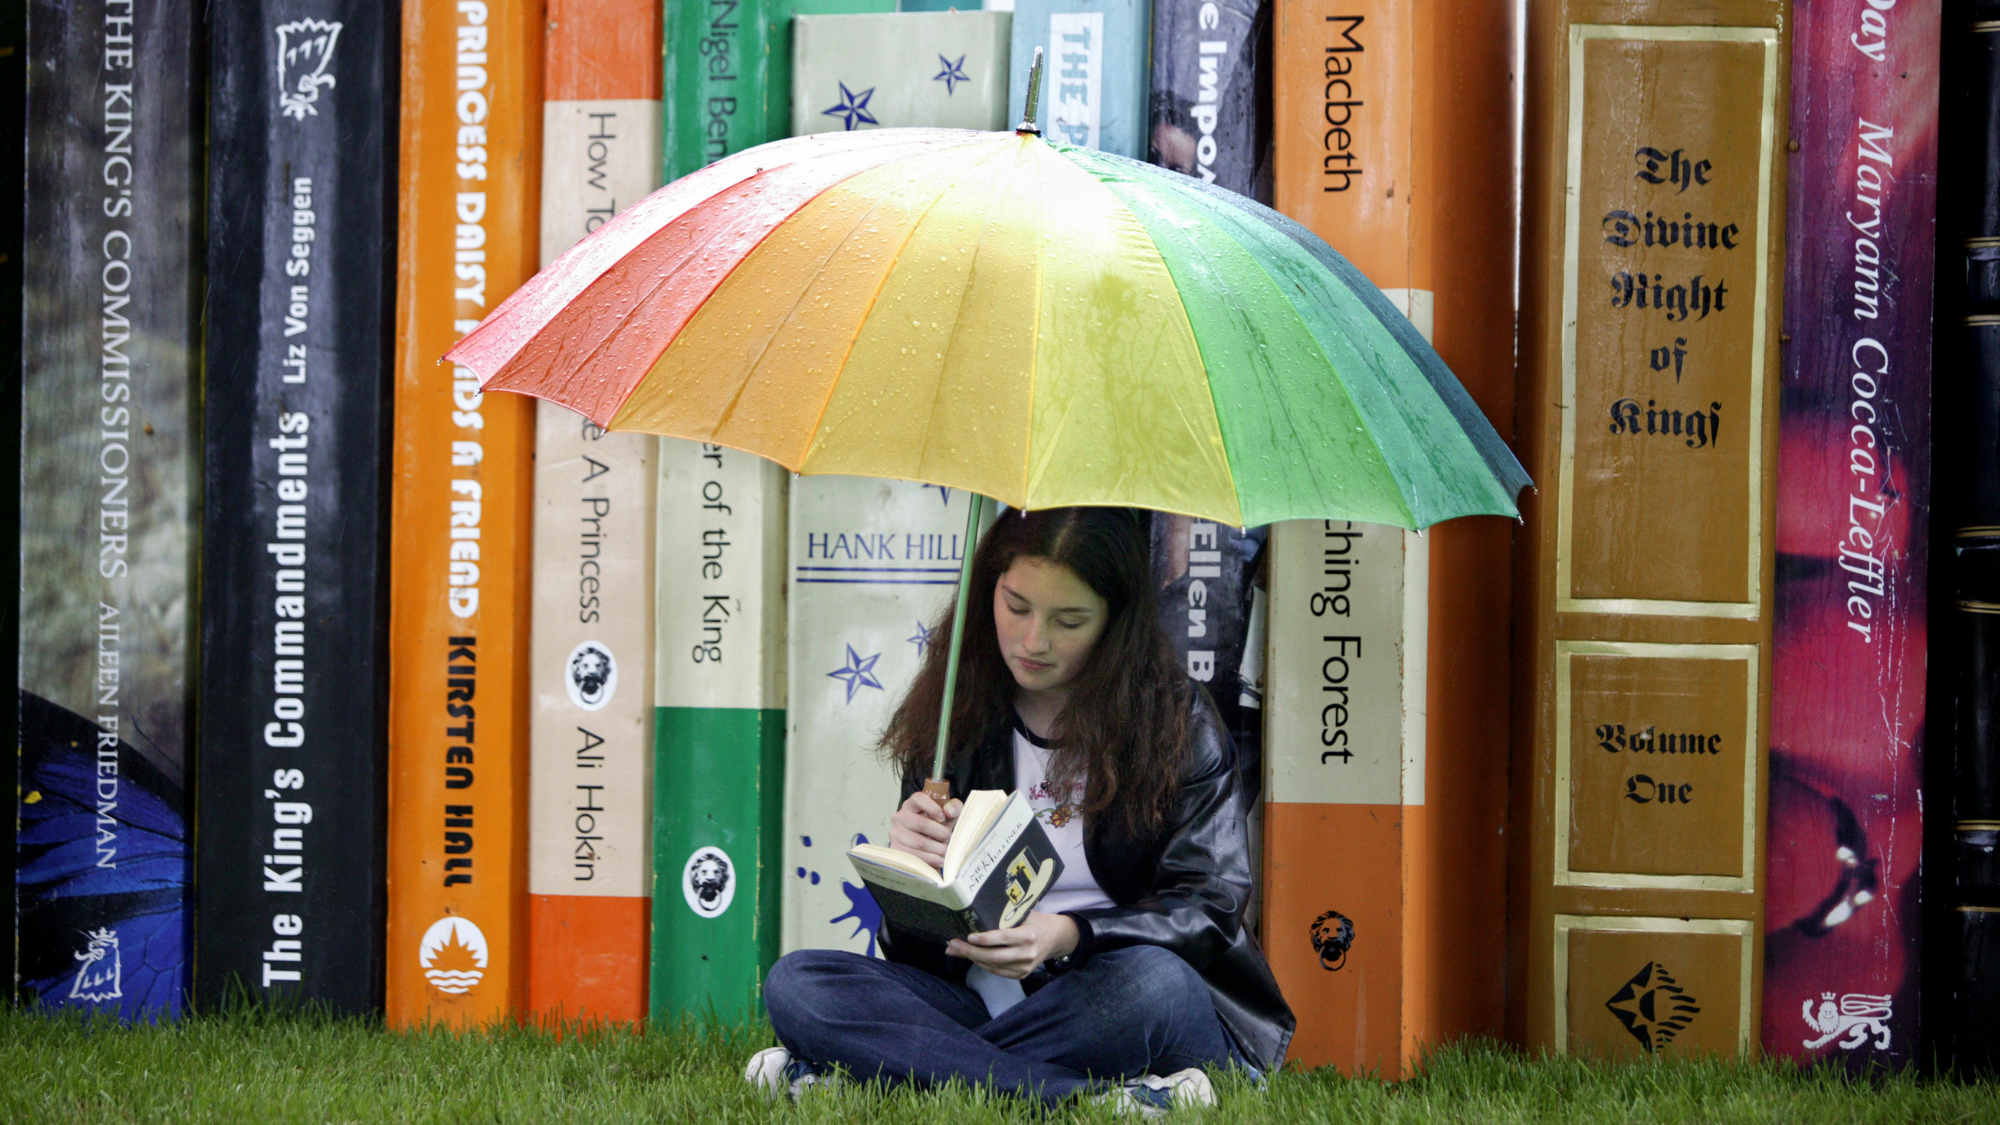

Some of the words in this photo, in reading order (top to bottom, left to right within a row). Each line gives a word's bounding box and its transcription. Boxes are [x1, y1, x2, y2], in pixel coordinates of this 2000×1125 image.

[104, 0, 133, 70] THE
[700, 0, 740, 81] Nigel
[1059, 26, 1091, 107] THE
[456, 0, 489, 181] PRINCESS
[707, 97, 738, 164] Ben
[1323, 15, 1365, 192] Macbeth
[103, 82, 133, 217] KING'S
[587, 113, 617, 190] How
[1634, 146, 1713, 196] The
[285, 177, 315, 277] Seggen
[453, 191, 486, 307] DAISY
[1602, 210, 1740, 250] Divine
[1846, 117, 1894, 321] Maryann
[283, 286, 309, 337] Von
[1611, 271, 1728, 322] Right
[282, 345, 307, 384] Liz
[1650, 337, 1688, 385] of
[99, 230, 132, 579] COMMISSIONERS
[581, 454, 610, 483] A
[702, 481, 732, 516] of
[1838, 337, 1889, 643] Cocca-Leffler
[263, 411, 310, 748] Commandments
[448, 479, 482, 619] FRIEND
[579, 497, 611, 624] Princess
[702, 528, 732, 580] the
[808, 532, 895, 560] HANK
[905, 534, 963, 561] HILL
[1187, 523, 1222, 638] Ellen
[97, 601, 121, 708] AILEEN
[692, 596, 731, 664] King
[446, 636, 477, 789] KIRSTEN
[1321, 636, 1362, 765] Forest
[1596, 724, 1723, 755] Volume
[576, 726, 606, 768] Ali
[95, 714, 119, 870] FRIEDMAN
[1624, 774, 1693, 804] One
[263, 768, 313, 892] King's
[443, 805, 474, 888] HALL
[574, 785, 605, 881] Hokin
[982, 822, 1023, 871] MULLINER
[262, 914, 304, 988] The
